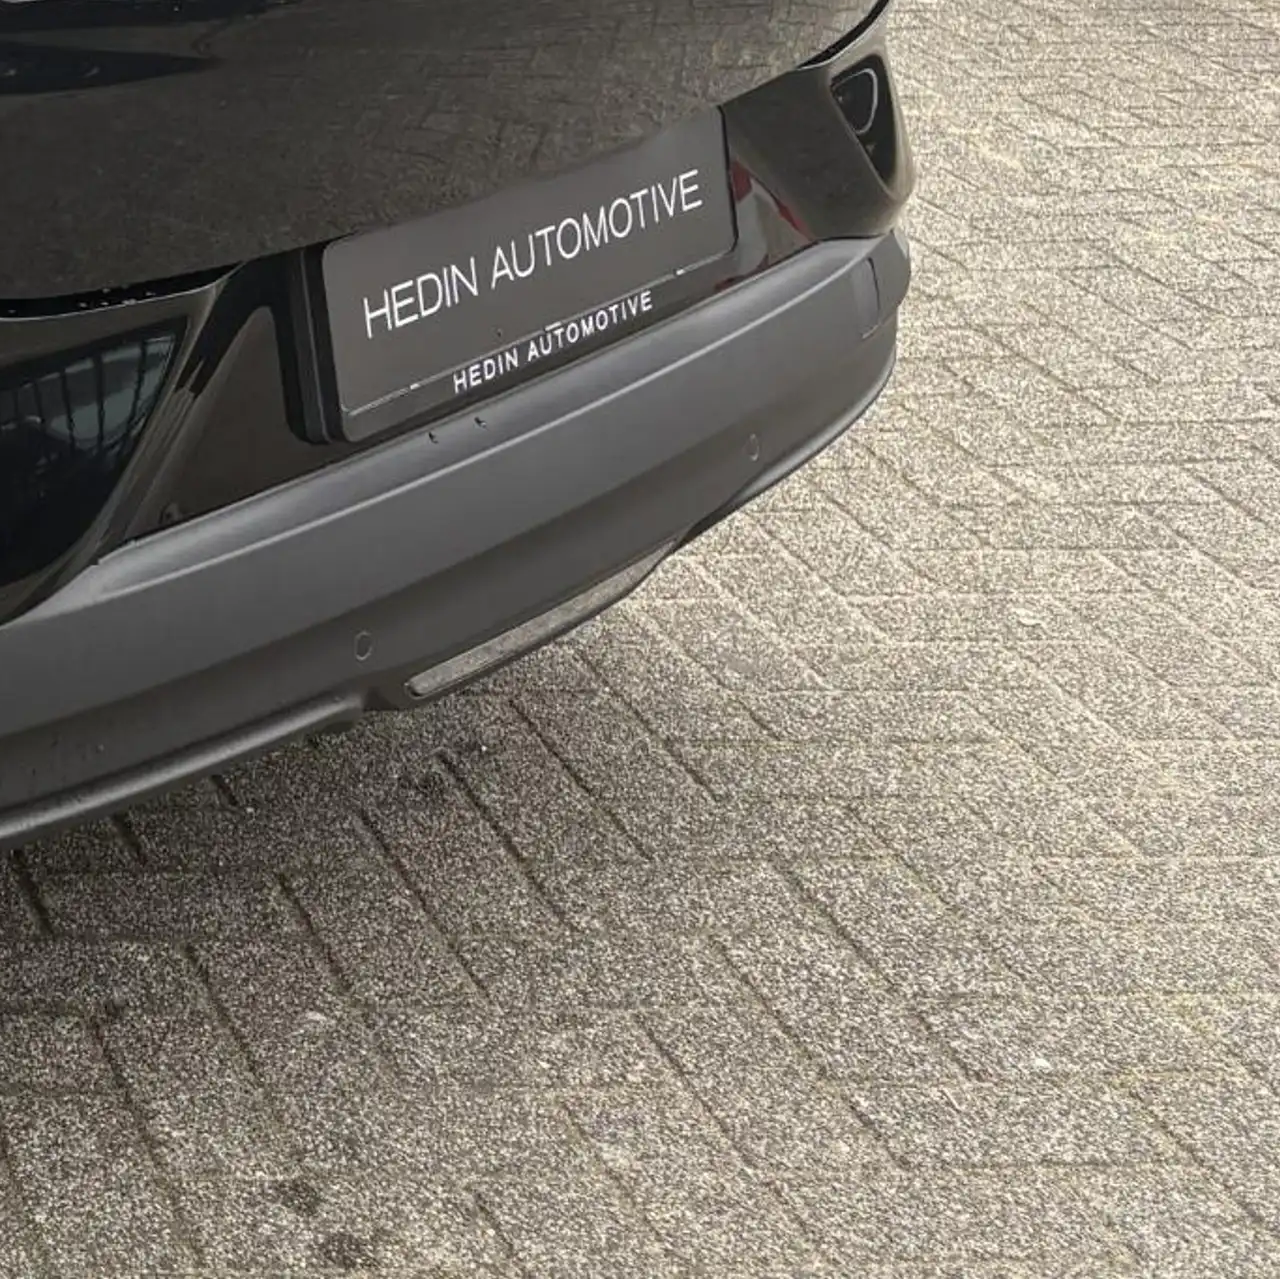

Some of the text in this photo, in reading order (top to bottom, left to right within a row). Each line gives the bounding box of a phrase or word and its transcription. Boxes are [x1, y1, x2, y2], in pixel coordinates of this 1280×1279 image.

[362, 168, 704, 340] HEDIN AUTOMOTIVE
[452, 290, 654, 395] HEDIN AUTOMOTIVE
